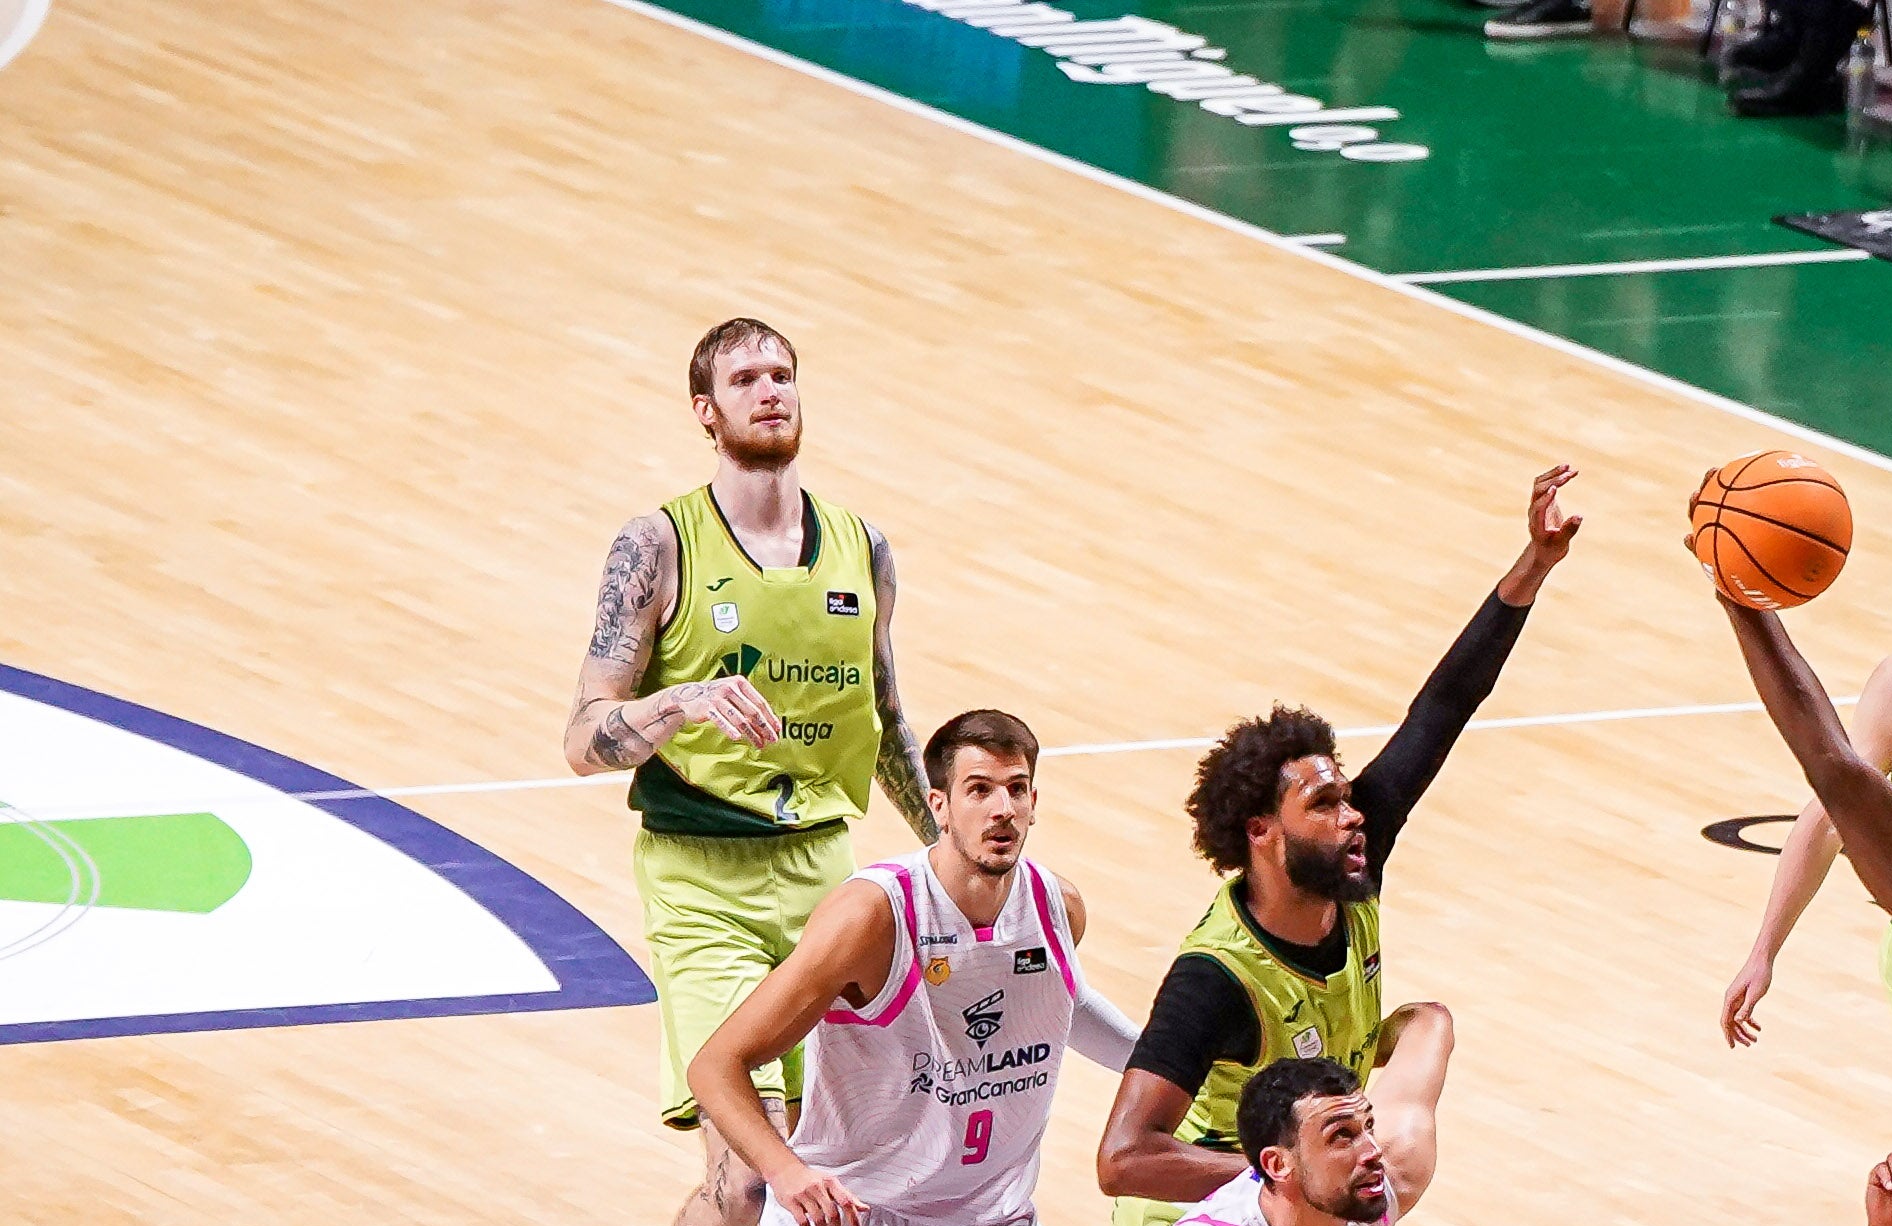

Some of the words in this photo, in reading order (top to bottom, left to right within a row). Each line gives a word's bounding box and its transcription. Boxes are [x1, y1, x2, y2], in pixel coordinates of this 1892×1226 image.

[767, 658, 861, 691] Unicaja
[781, 716, 834, 747] laga
[912, 1042, 1051, 1083] DREAMLAND
[936, 1070, 1048, 1107] GranCanaria
[961, 1109, 993, 1166] 9
